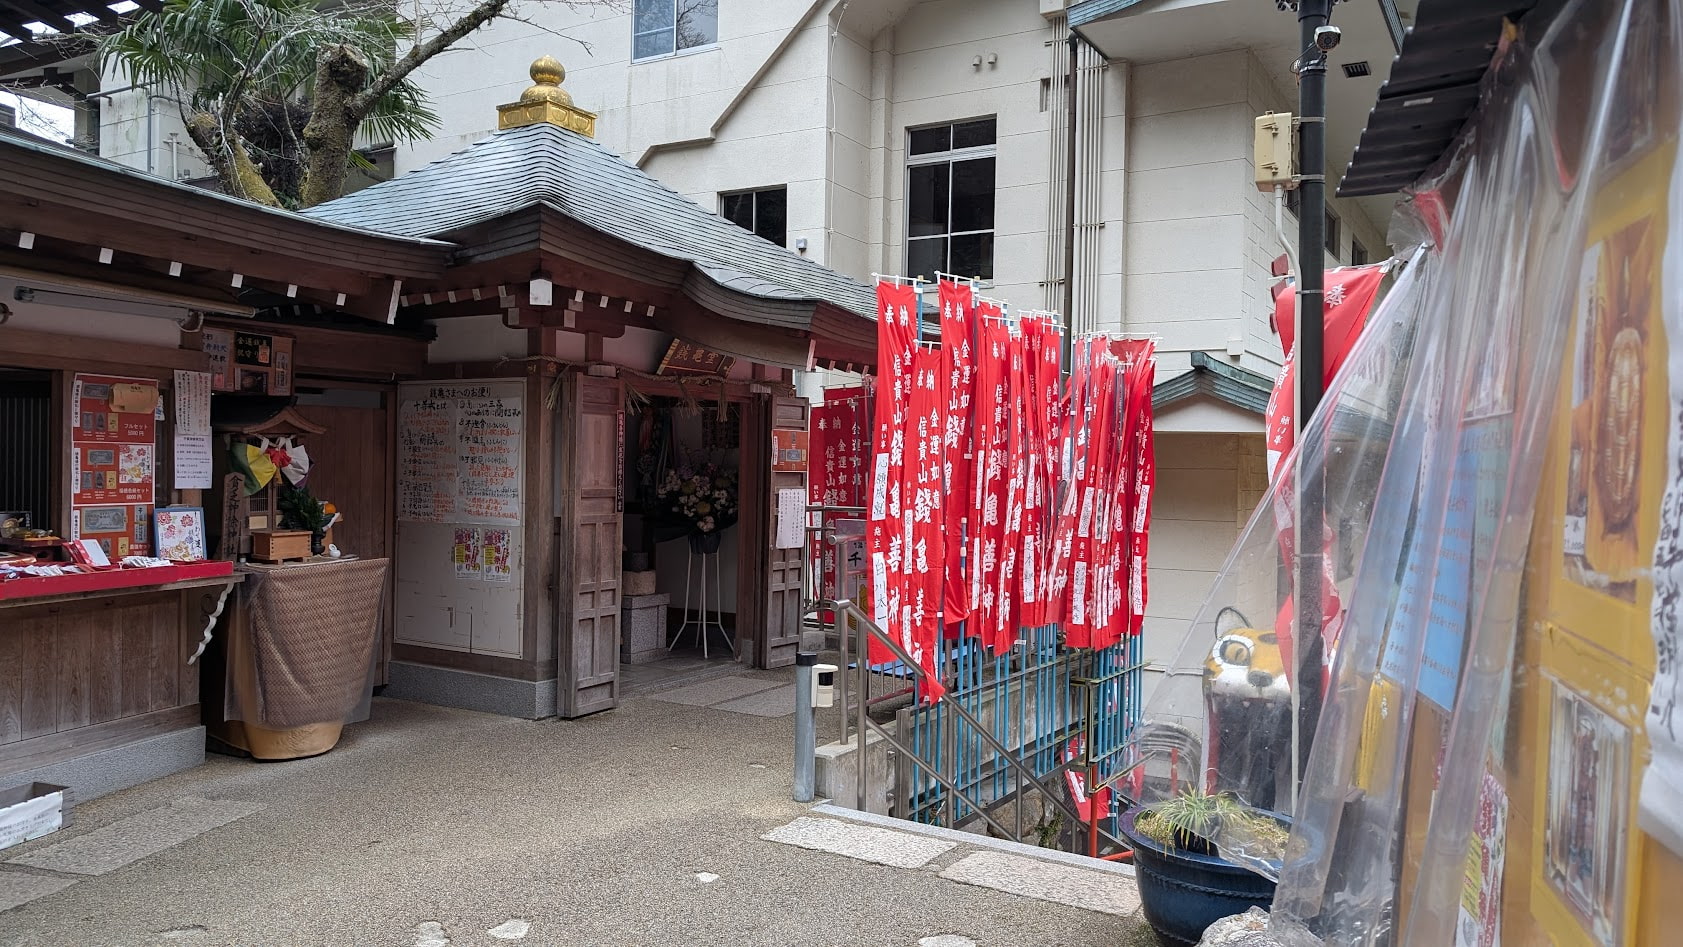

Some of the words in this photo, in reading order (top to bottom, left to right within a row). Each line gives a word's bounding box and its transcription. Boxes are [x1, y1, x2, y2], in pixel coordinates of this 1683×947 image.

[885, 303, 909, 327] 奉納
[944, 300, 964, 322] 奉納
[916, 368, 935, 391] 奉納
[818, 417, 842, 432] 奉納
[929, 407, 941, 510] 金運如意
[838, 438, 847, 503] 金運如意
